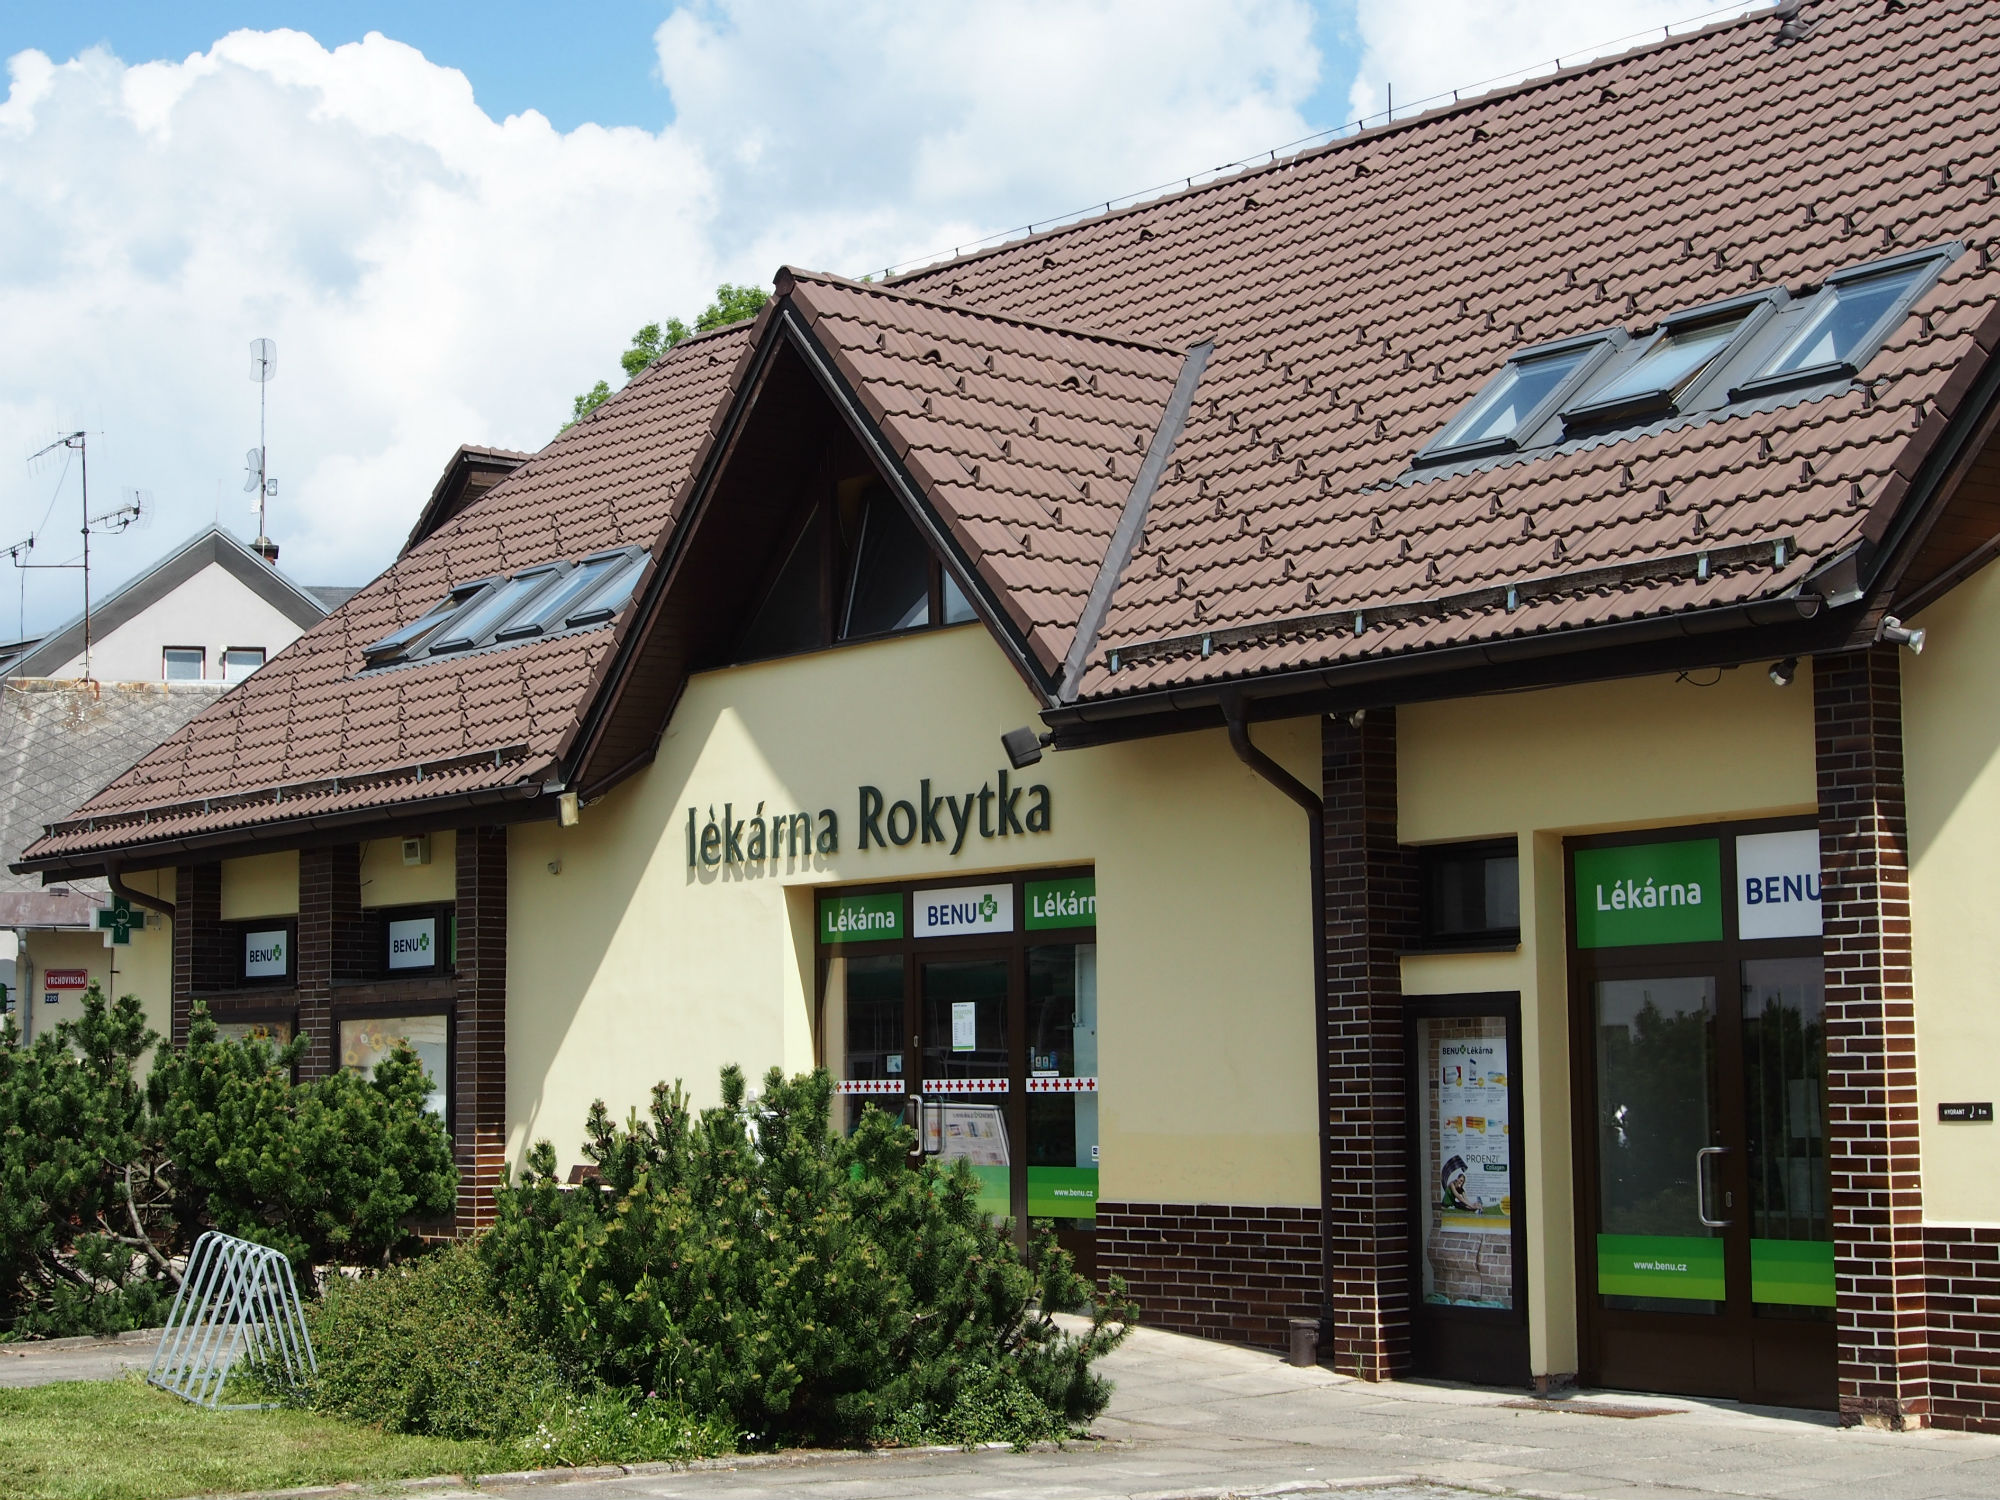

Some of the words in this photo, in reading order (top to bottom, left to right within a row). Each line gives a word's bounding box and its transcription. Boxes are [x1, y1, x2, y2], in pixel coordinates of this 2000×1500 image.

[857, 769, 1051, 855] Rokytka
[1596, 876, 1702, 911] Lékárna
[1745, 873, 1821, 904] BENU
[927, 902, 977, 927] BENU
[1033, 890, 1096, 918] Lékárn
[828, 908, 895, 933] Lékárna
[249, 948, 273, 963] BENU
[393, 938, 419, 954] BENU
[1442, 1047, 1460, 1055] BENU
[1466, 1046, 1493, 1055] Lékárna
[1054, 1188, 1094, 1197] www.benu.cz
[1634, 1260, 1687, 1272] www.benu.cz
